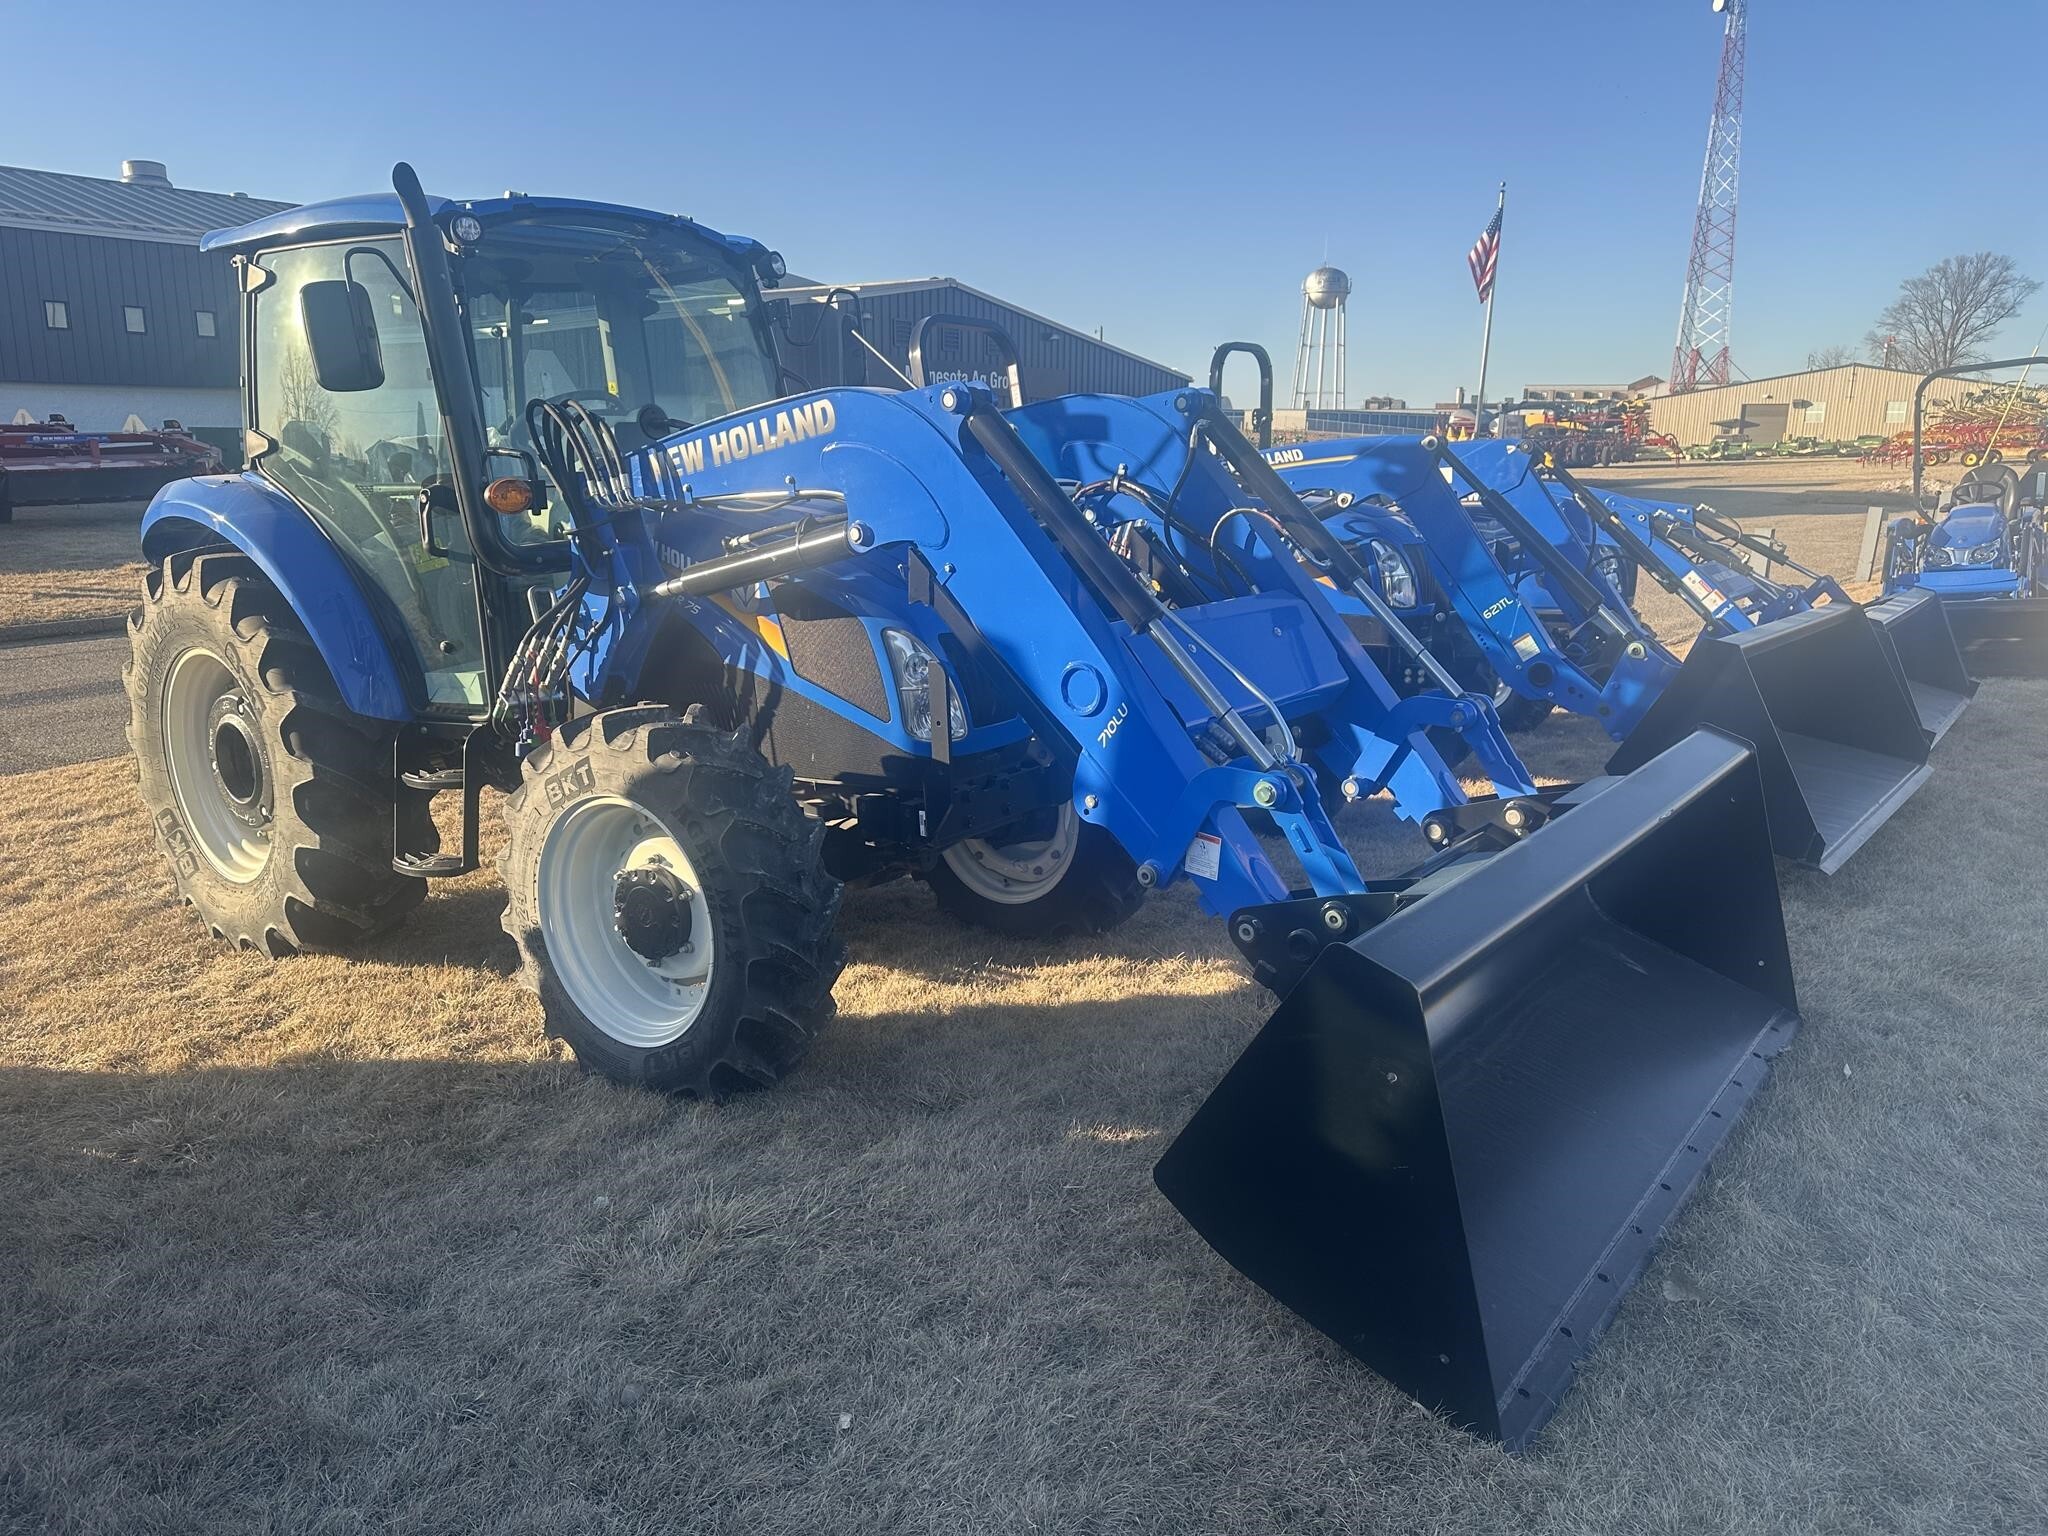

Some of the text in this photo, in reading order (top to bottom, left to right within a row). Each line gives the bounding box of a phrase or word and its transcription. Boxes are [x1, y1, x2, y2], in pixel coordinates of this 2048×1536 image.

[905, 365, 968, 385] Mnesota
[990, 371, 1009, 389] Gro
[708, 399, 836, 468] HOLLAND
[1260, 448, 1304, 465] LAND
[1483, 597, 1514, 619] 621TL
[1097, 702, 1128, 749] 710LU
[548, 760, 594, 806] BKT
[158, 809, 199, 879] BKT
